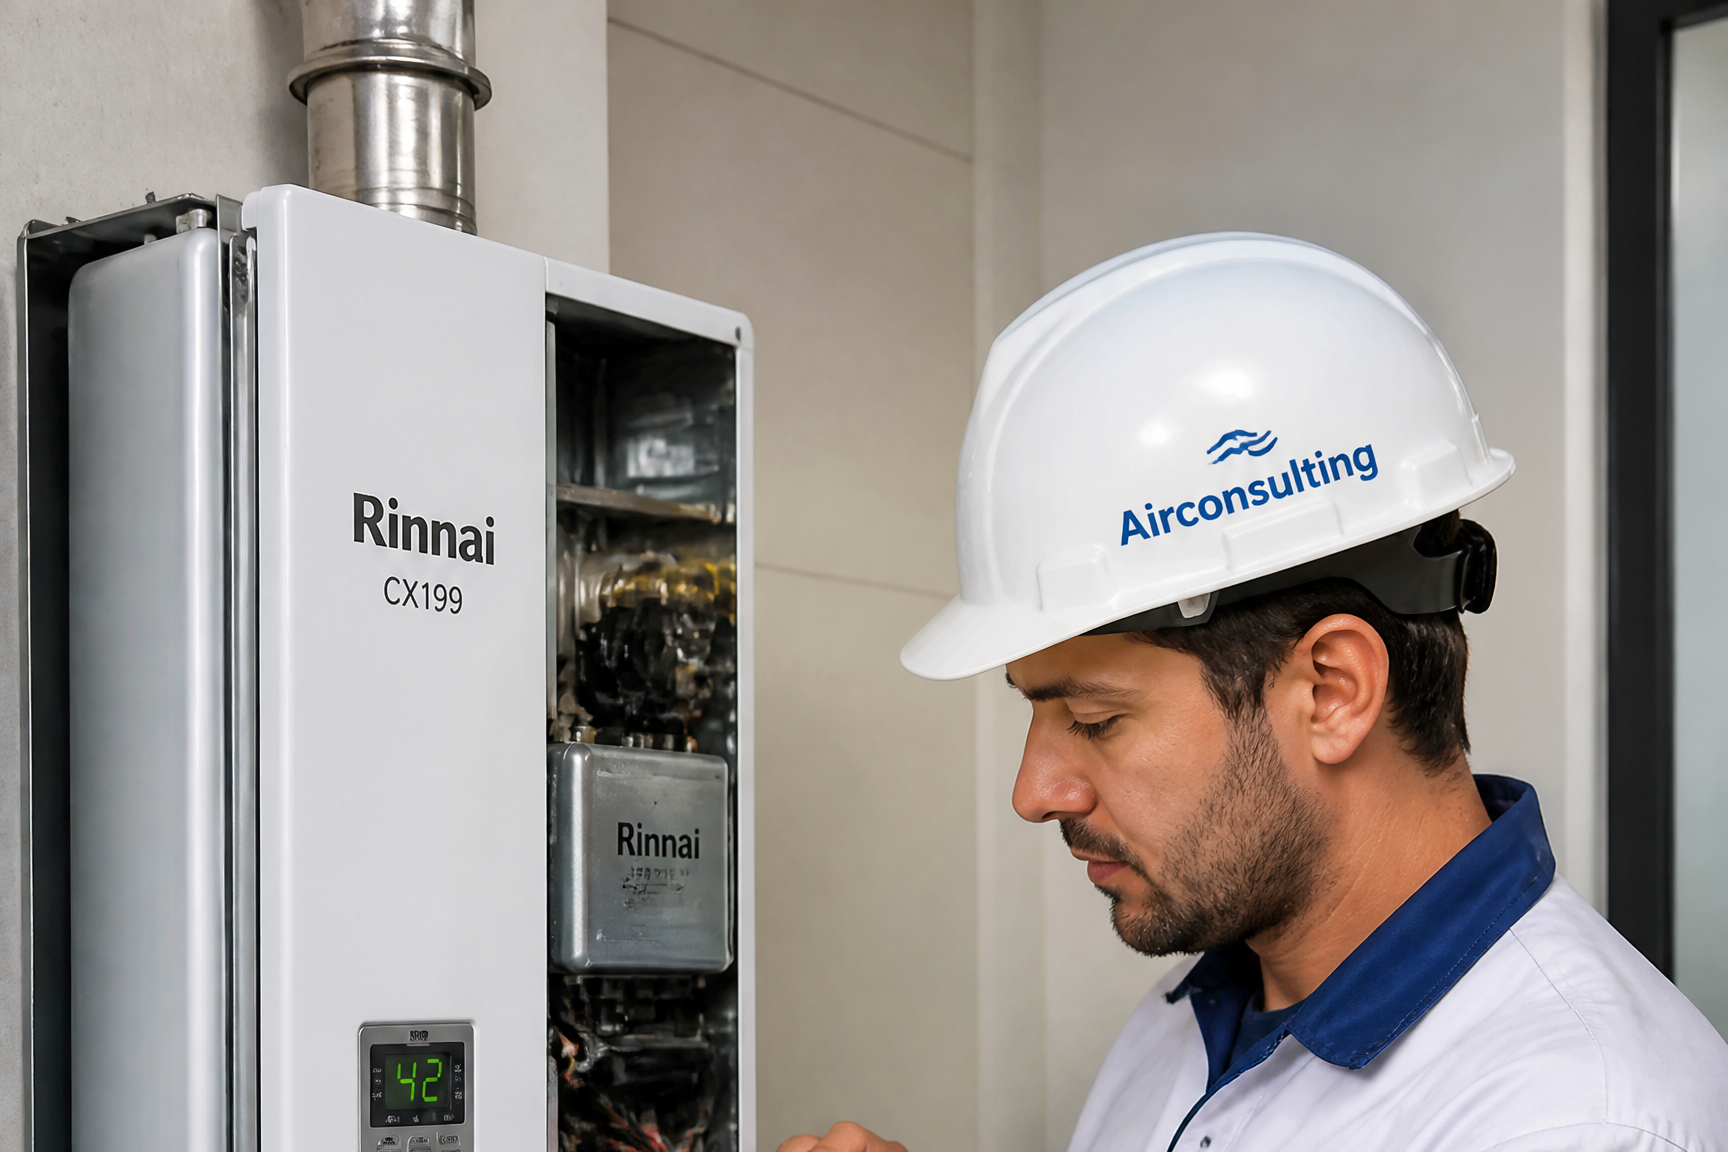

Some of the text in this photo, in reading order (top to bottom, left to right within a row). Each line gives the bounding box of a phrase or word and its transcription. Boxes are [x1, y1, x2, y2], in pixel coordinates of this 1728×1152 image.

[1120, 444, 1379, 546] Airconsulting
[353, 492, 495, 566] Rinnai
[383, 576, 463, 615] CX199
[617, 821, 700, 859] Rinnai
[397, 1058, 443, 1102] 42
